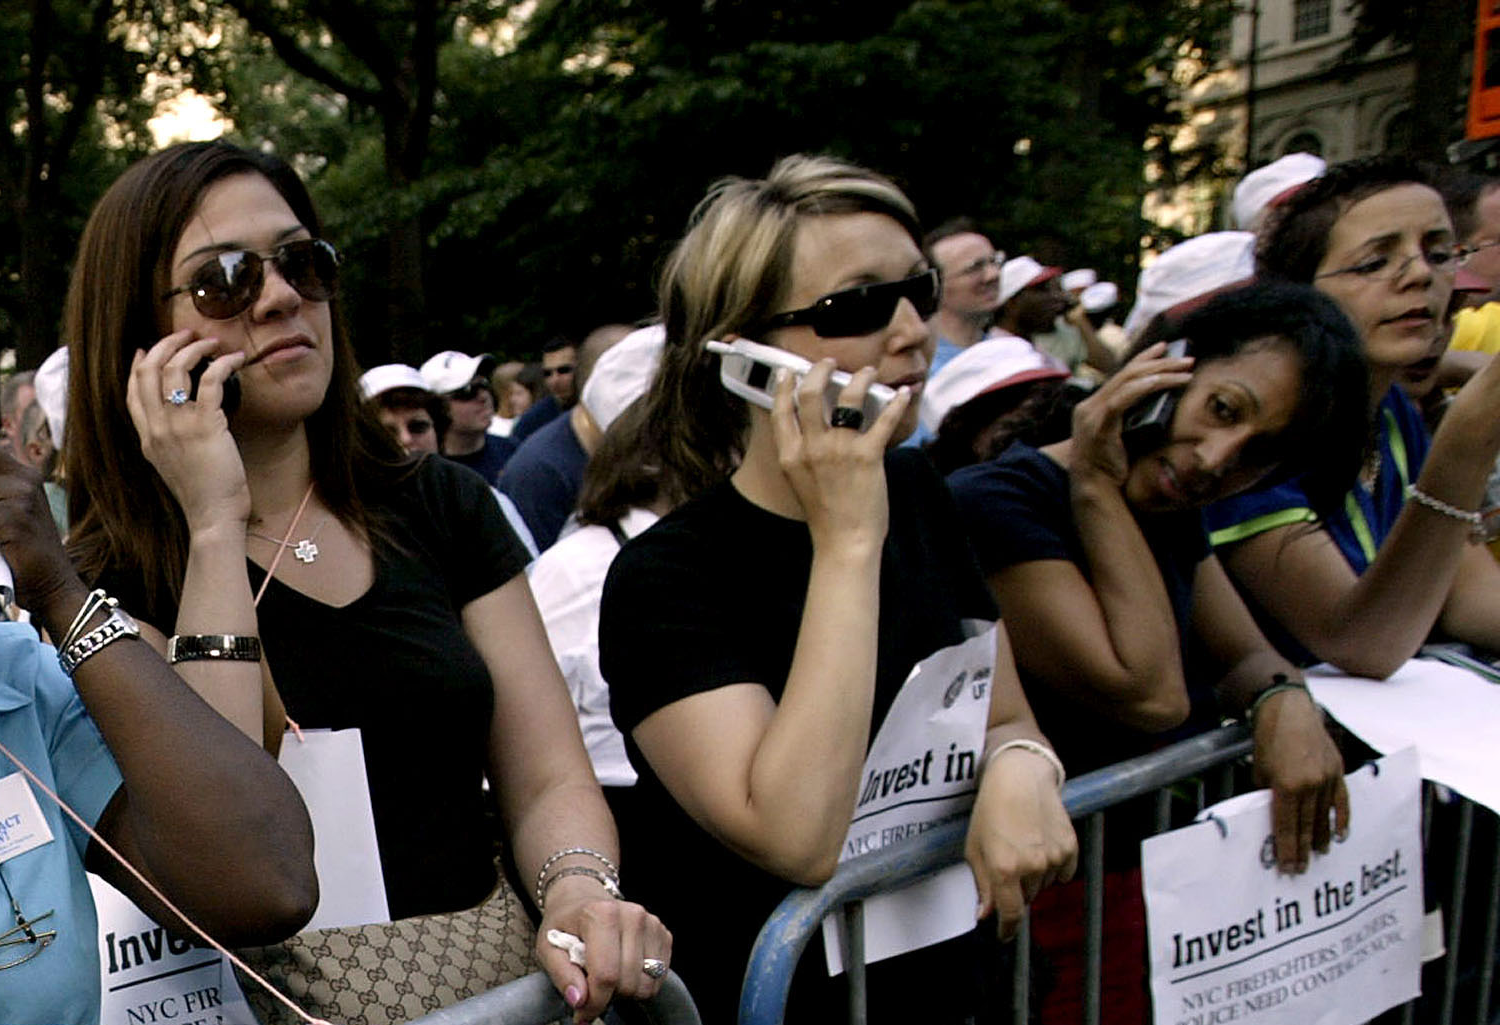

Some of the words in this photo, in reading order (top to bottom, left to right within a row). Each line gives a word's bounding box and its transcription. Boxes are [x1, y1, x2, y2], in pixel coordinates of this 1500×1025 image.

[858, 749, 934, 807] Invest
[944, 743, 975, 782] in
[1172, 908, 1266, 969] Invest
[1275, 898, 1303, 933] in
[1314, 881, 1356, 919] the
[1360, 849, 1408, 897] best.
[1181, 986, 1223, 1013] NYC
[1243, 987, 1290, 1016] NEED
